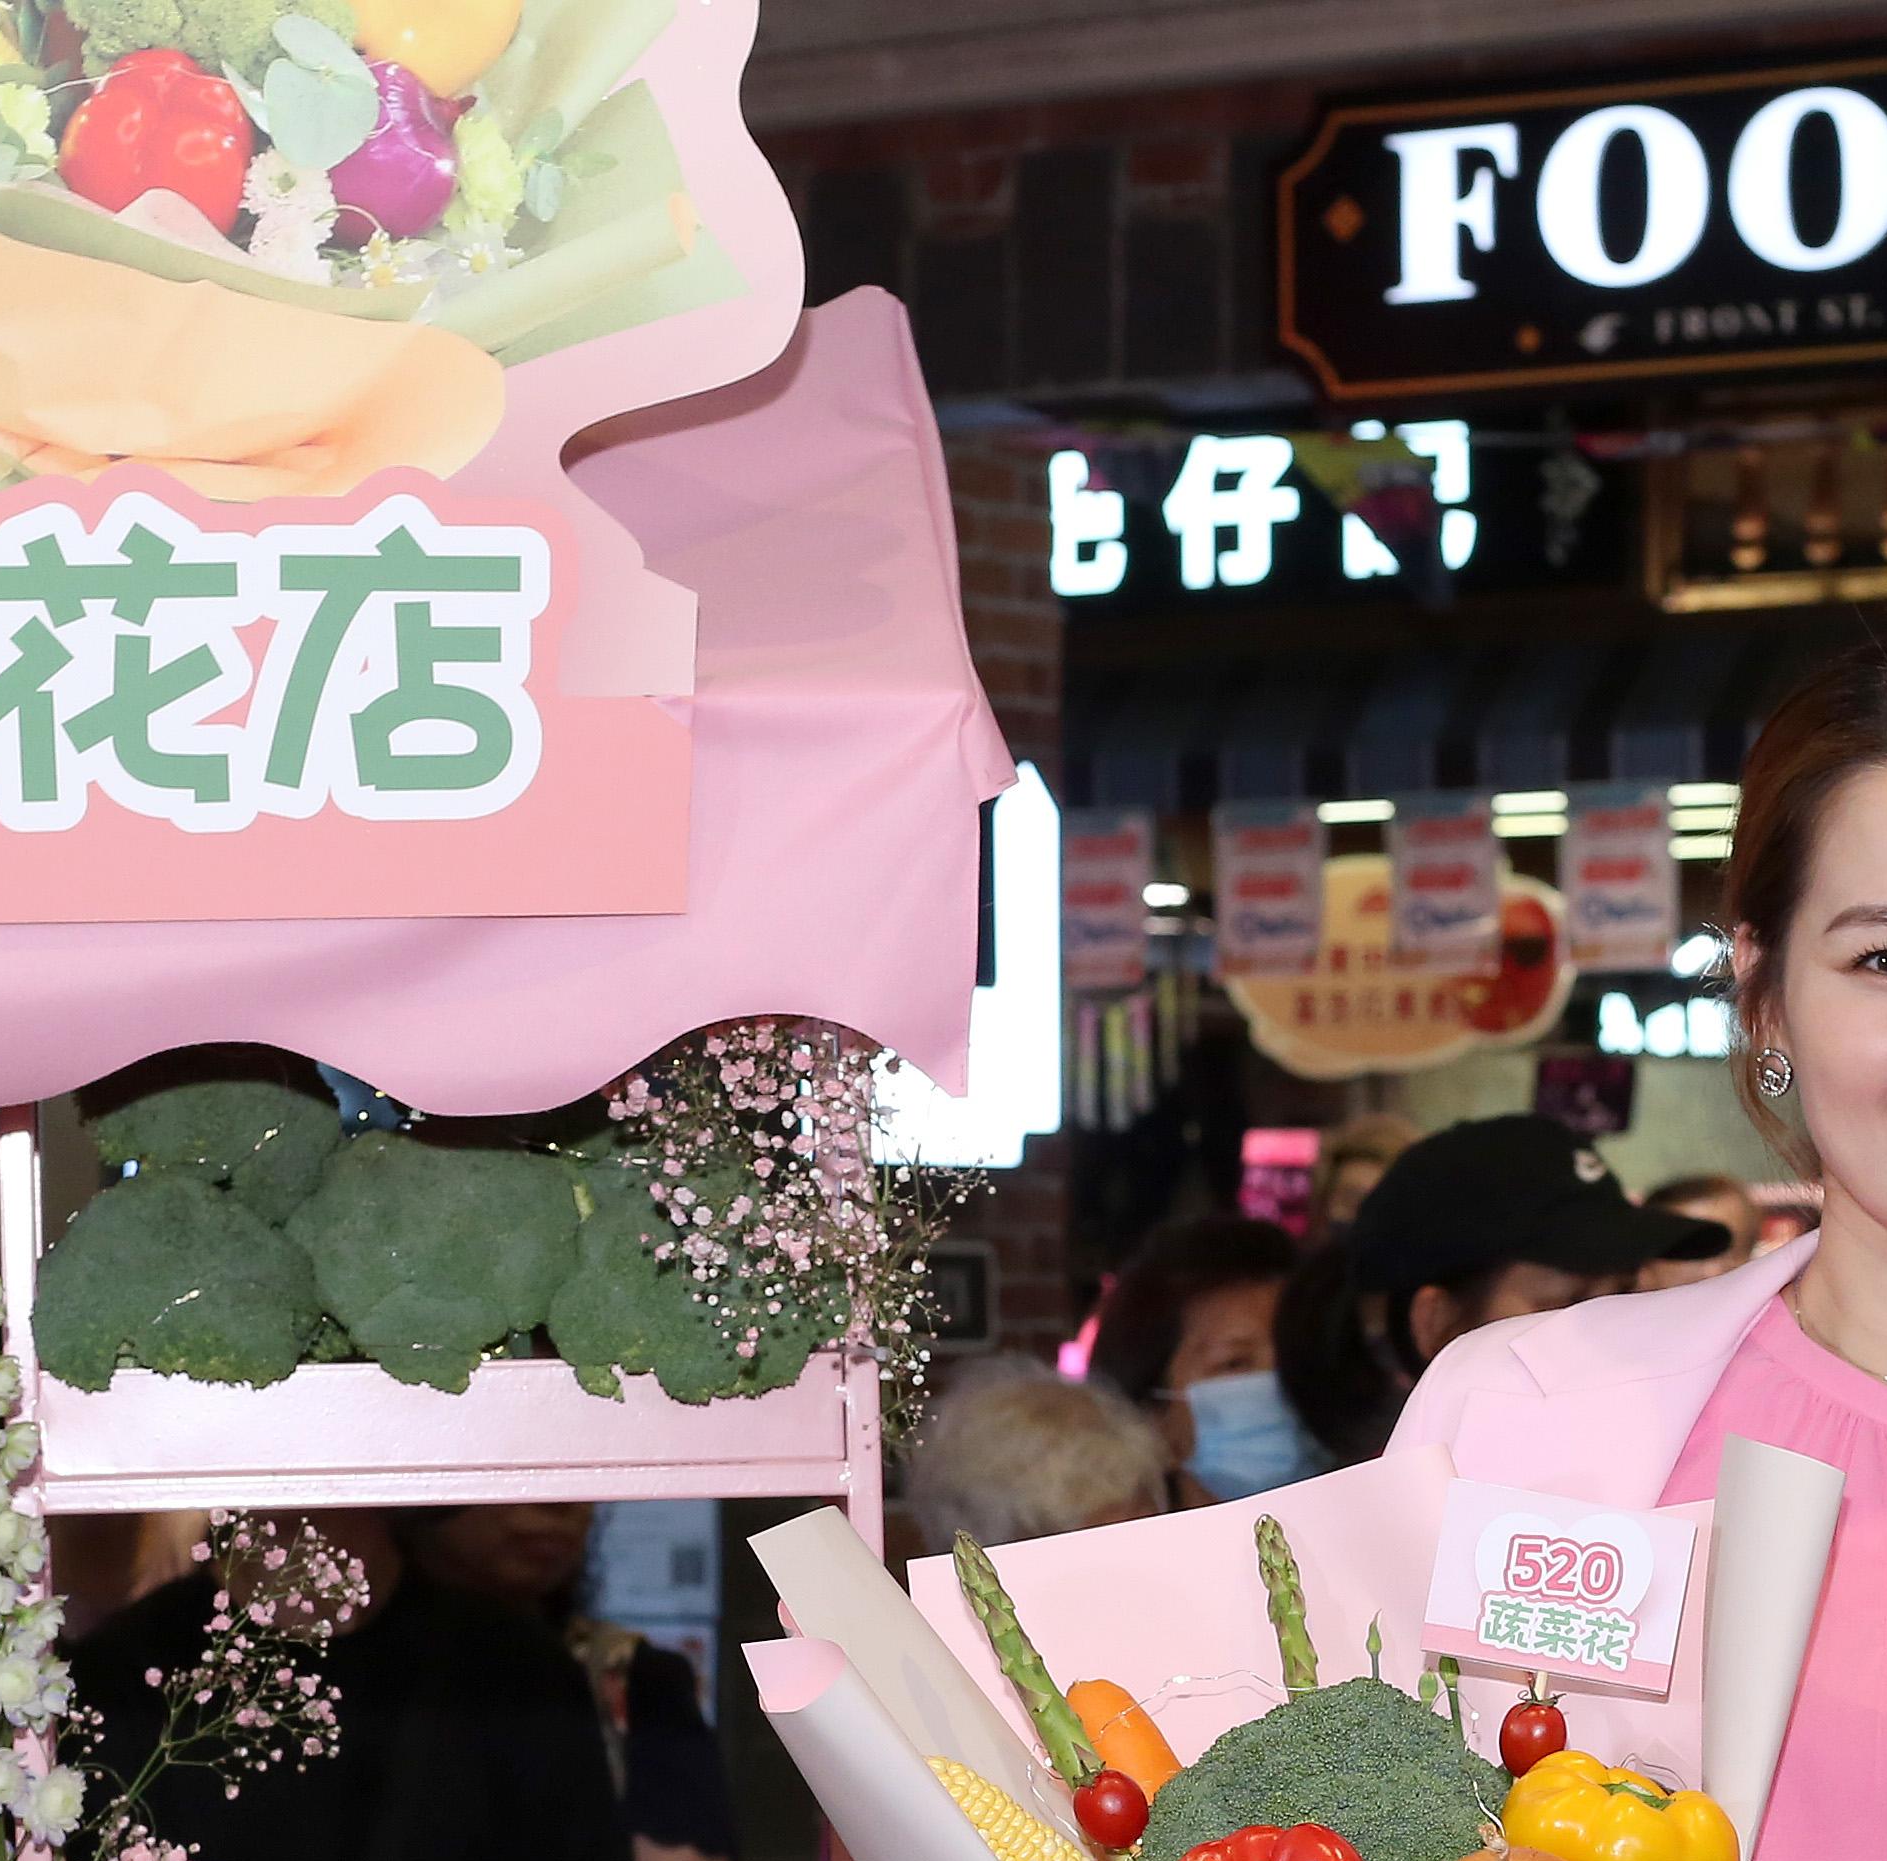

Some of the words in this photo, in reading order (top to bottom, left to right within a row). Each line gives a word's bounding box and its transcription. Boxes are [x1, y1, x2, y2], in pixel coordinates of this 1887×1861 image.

[1511, 1542, 1617, 1598] 520
[1483, 1599, 1631, 1668] 蔬菜花
